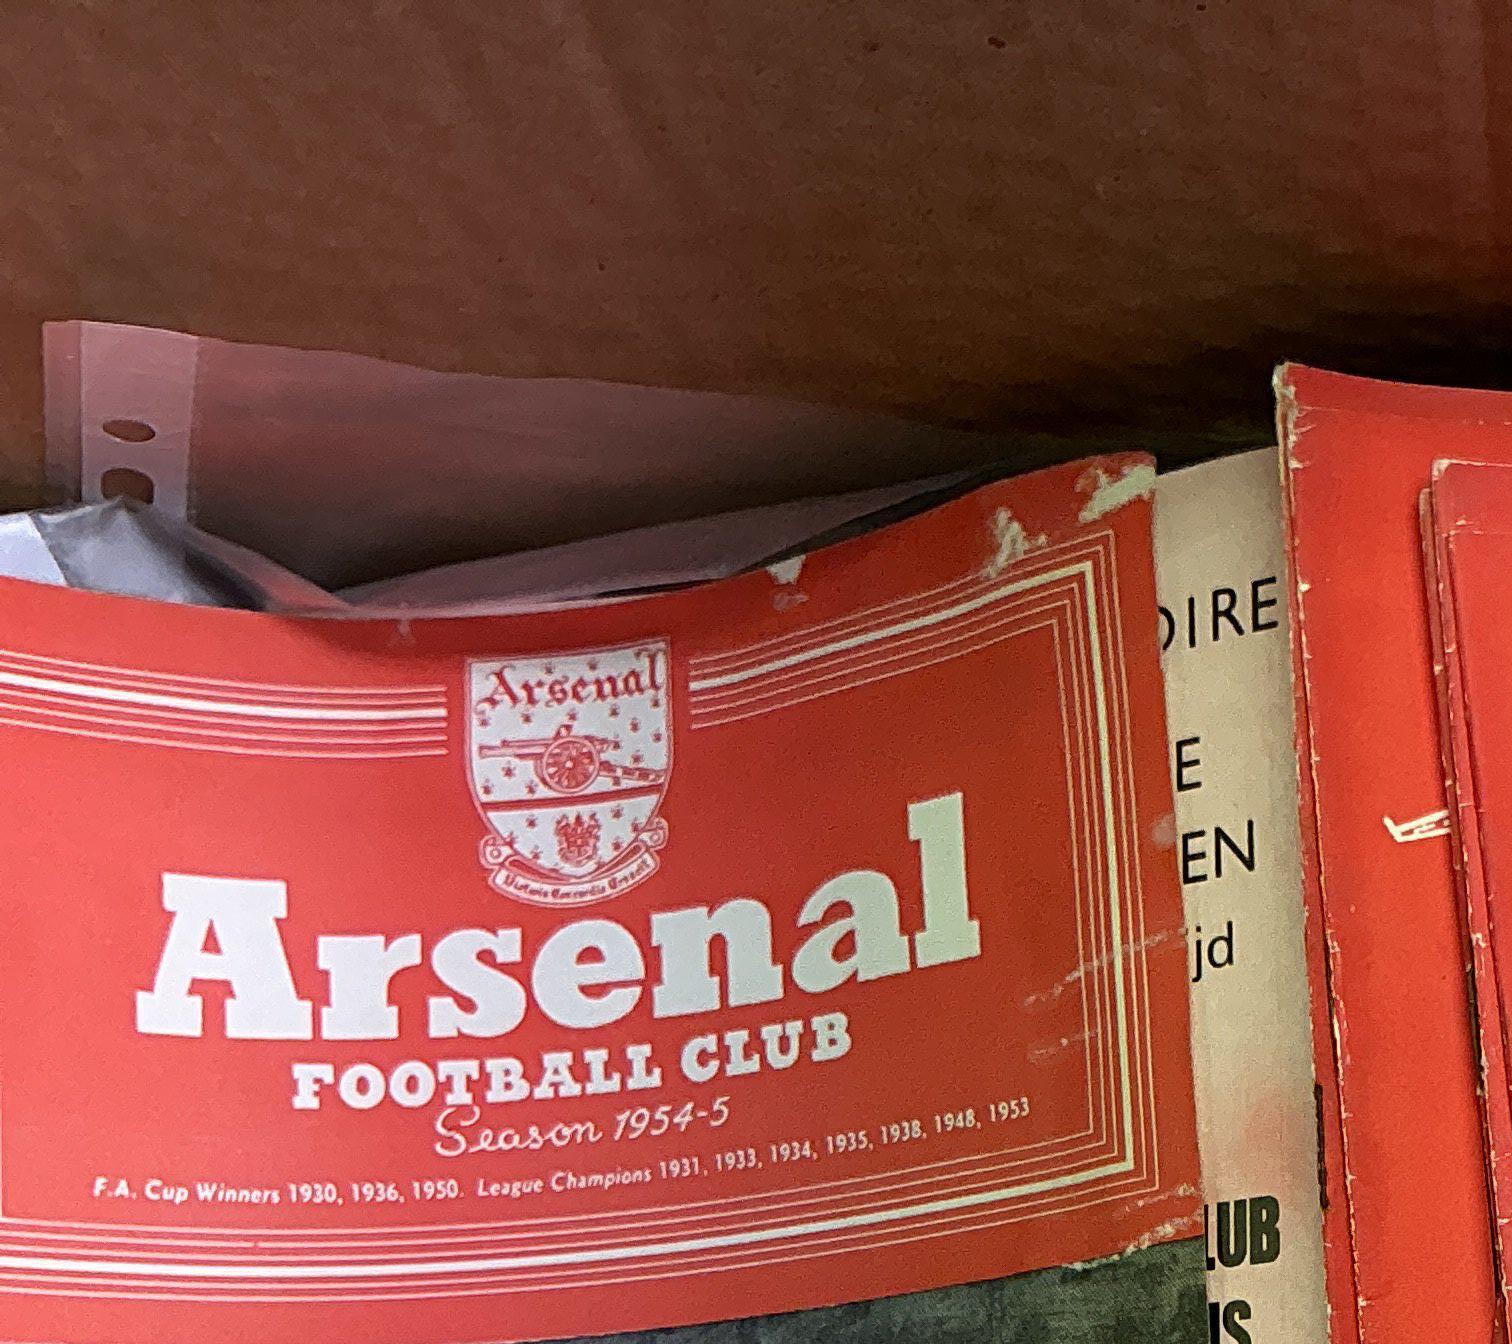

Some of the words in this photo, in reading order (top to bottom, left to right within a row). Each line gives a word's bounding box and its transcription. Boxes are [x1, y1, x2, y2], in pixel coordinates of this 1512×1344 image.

[476, 651, 662, 708] Arsenal
[136, 790, 981, 1042] Arsenal
[292, 1045, 662, 1111] FOOTBALL
[682, 1014, 853, 1081] CLUB
[93, 1176, 137, 1199] F.A.
[144, 1178, 188, 1205] Cup
[197, 1181, 280, 1204] Winners
[289, 1182, 343, 1206] 1930,
[351, 1181, 405, 1204] 1936,
[412, 1179, 464, 1199] 1950.
[477, 1176, 543, 1199] League
[551, 1165, 652, 1194] Champions
[714, 1151, 763, 1173] 1933,
[769, 1142, 818, 1165] 1934,
[826, 1132, 874, 1156] 1935,
[934, 1109, 982, 1135] 1948,
[989, 1097, 1031, 1123] 1953
[434, 1103, 602, 1157] Season
[614, 1096, 731, 1143] 1954-5
